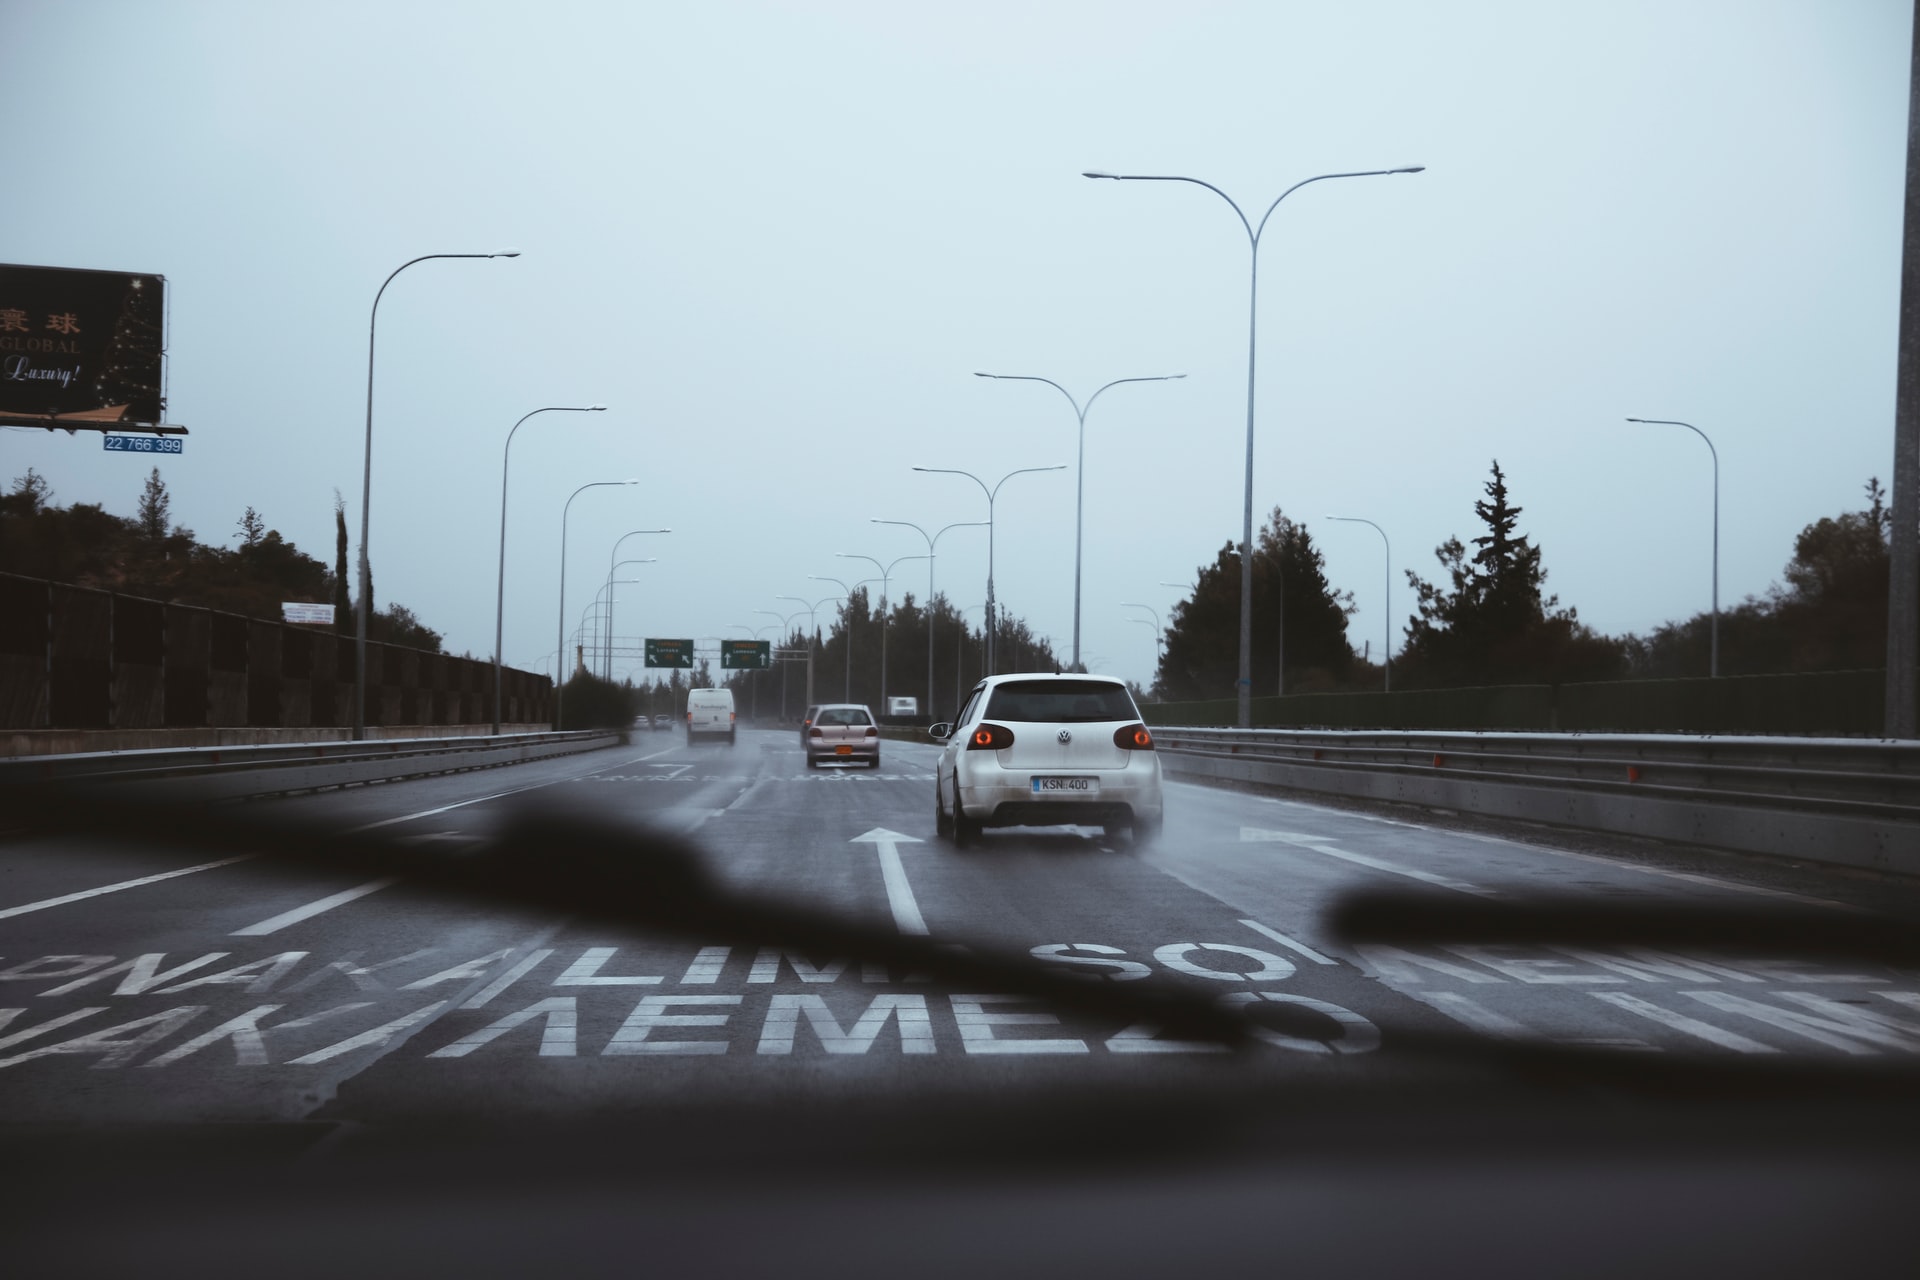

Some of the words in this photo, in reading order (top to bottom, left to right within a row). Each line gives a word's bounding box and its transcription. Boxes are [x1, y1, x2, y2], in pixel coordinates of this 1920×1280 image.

[0, 336, 80, 354] GLOBAL
[3, 354, 81, 389] Luxury!
[106, 437, 123, 450] 22
[127, 438, 151, 451] 766
[156, 439, 181, 452] 399
[1042, 779, 1063, 790] KSN
[1069, 779, 1088, 790] 400
